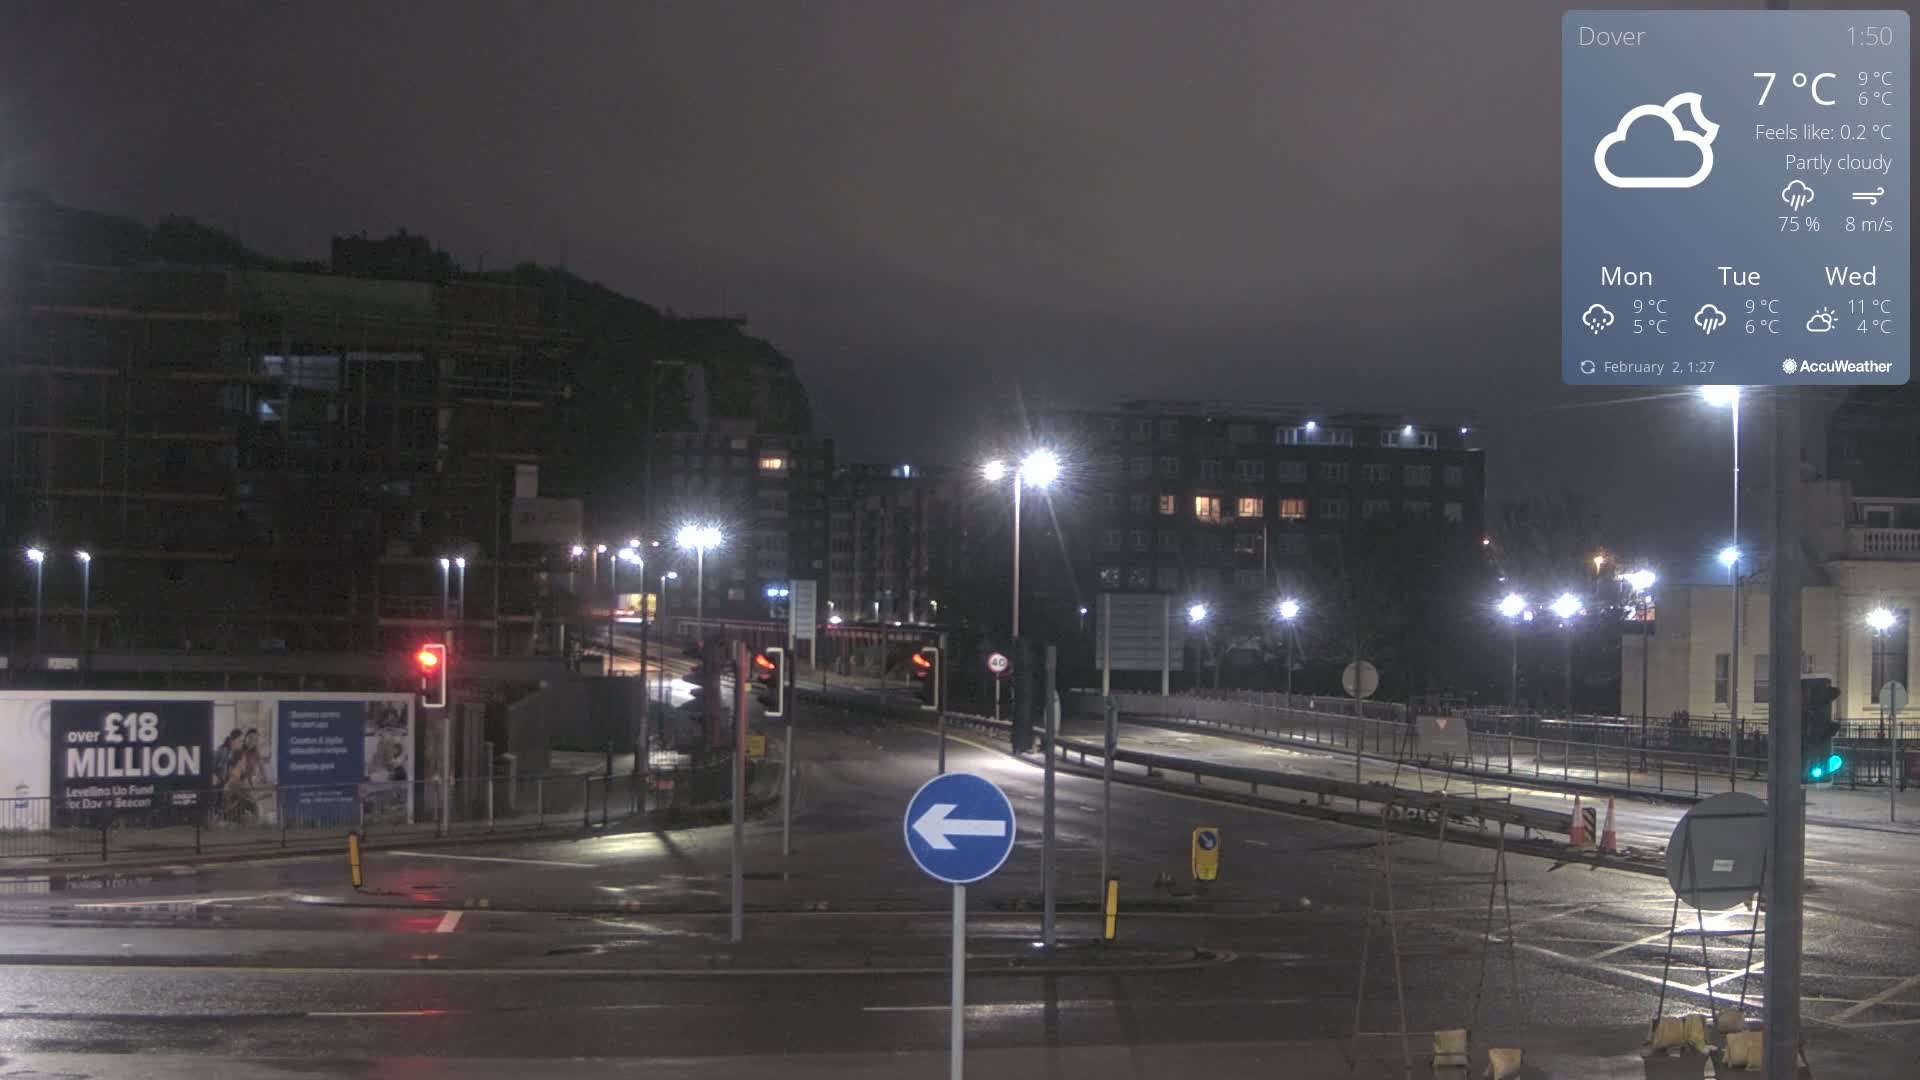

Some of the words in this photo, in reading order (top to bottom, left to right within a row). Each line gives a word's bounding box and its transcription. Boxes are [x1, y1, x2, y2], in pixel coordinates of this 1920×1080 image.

[68, 731, 100, 742] over
[105, 712, 158, 742] £18
[67, 746, 200, 778] MILLION
